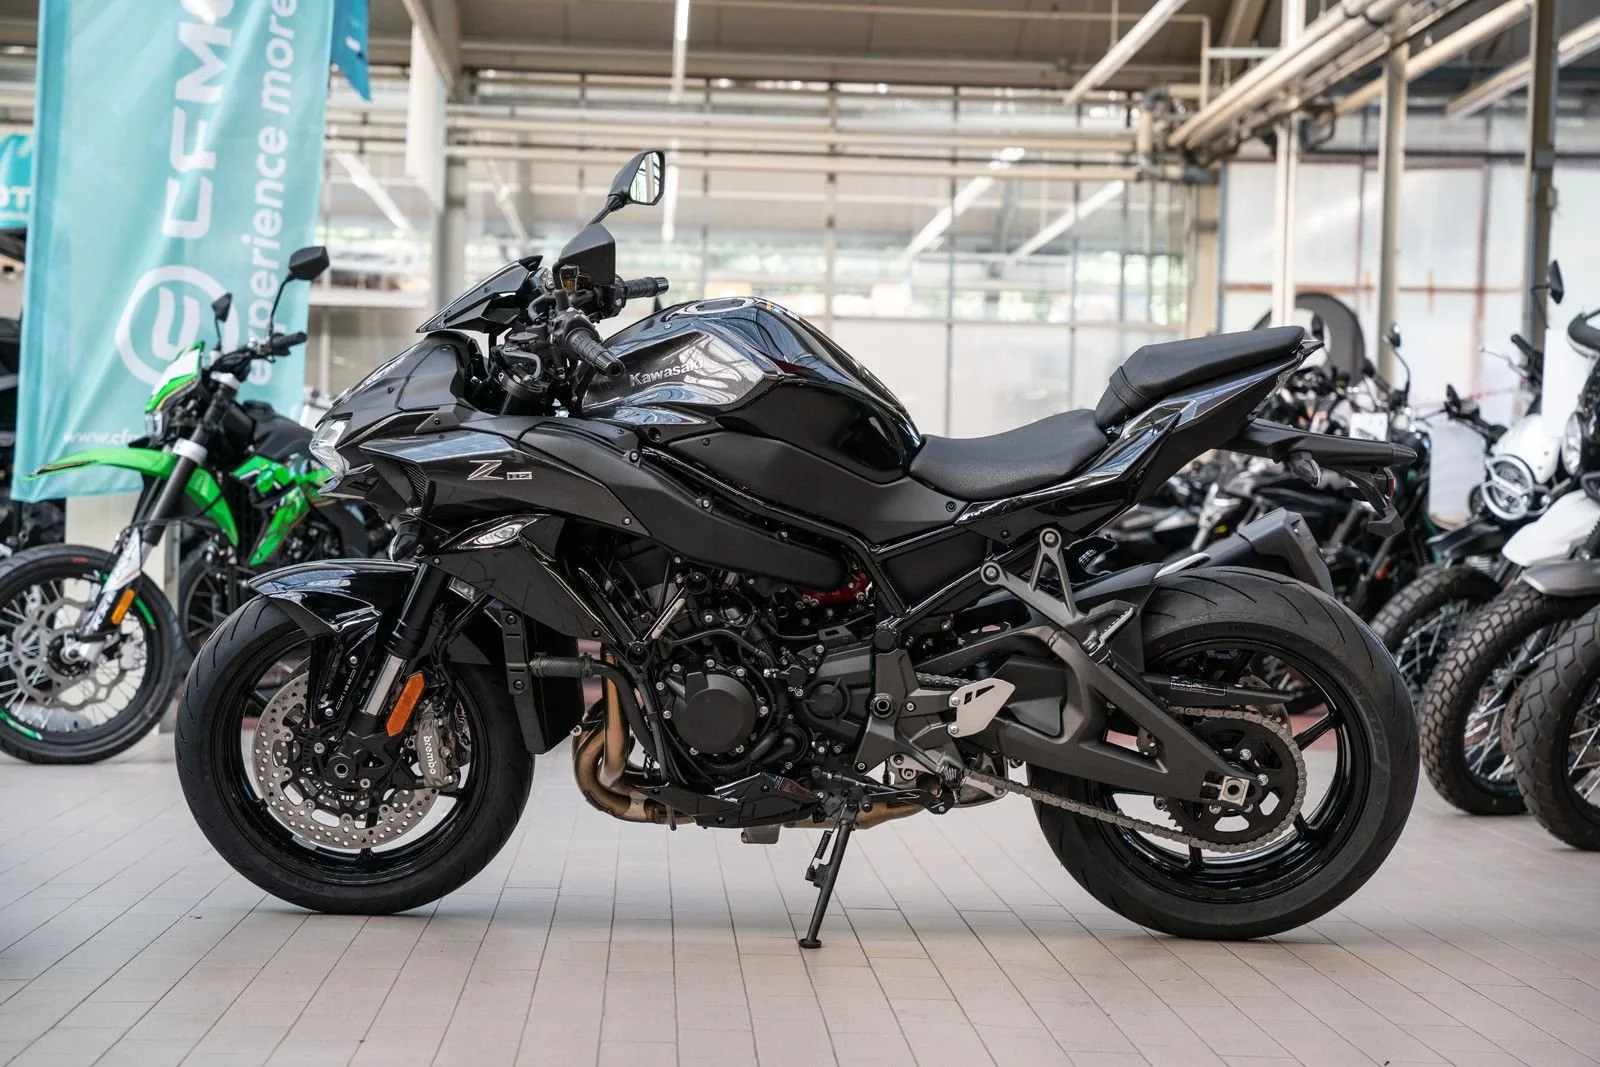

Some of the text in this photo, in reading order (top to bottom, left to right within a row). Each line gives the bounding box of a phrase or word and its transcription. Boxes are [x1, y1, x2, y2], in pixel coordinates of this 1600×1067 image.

[261, 0, 298, 115] more
[629, 359, 702, 387] Kawasaki
[466, 459, 504, 481] Z
[423, 735, 437, 775] brembo
